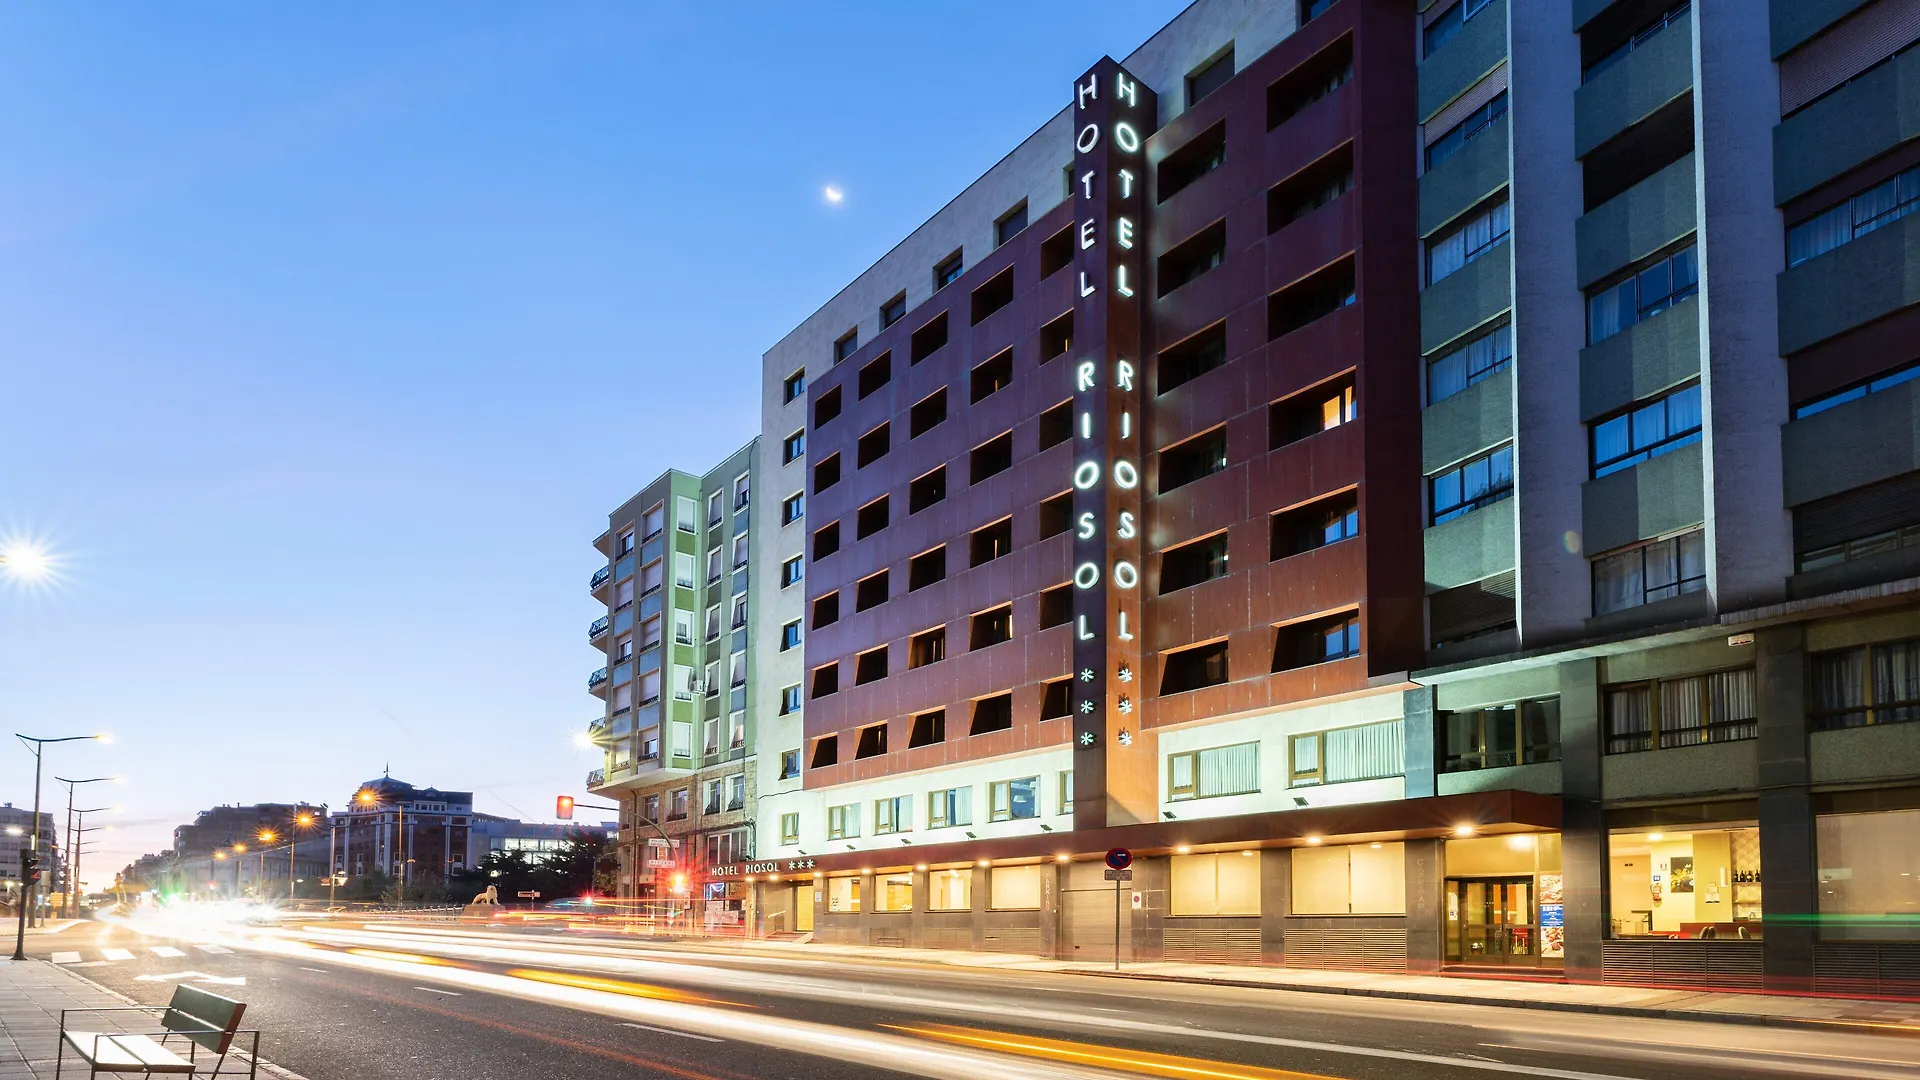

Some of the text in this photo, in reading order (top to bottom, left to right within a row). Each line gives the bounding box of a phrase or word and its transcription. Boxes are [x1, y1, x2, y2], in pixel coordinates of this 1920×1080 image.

[1075, 73, 1099, 640] HOTEL RIOSOL
[1114, 72, 1138, 641] HOTEL RIOSOL
[712, 862, 779, 876] HOTEL RIOSOL
